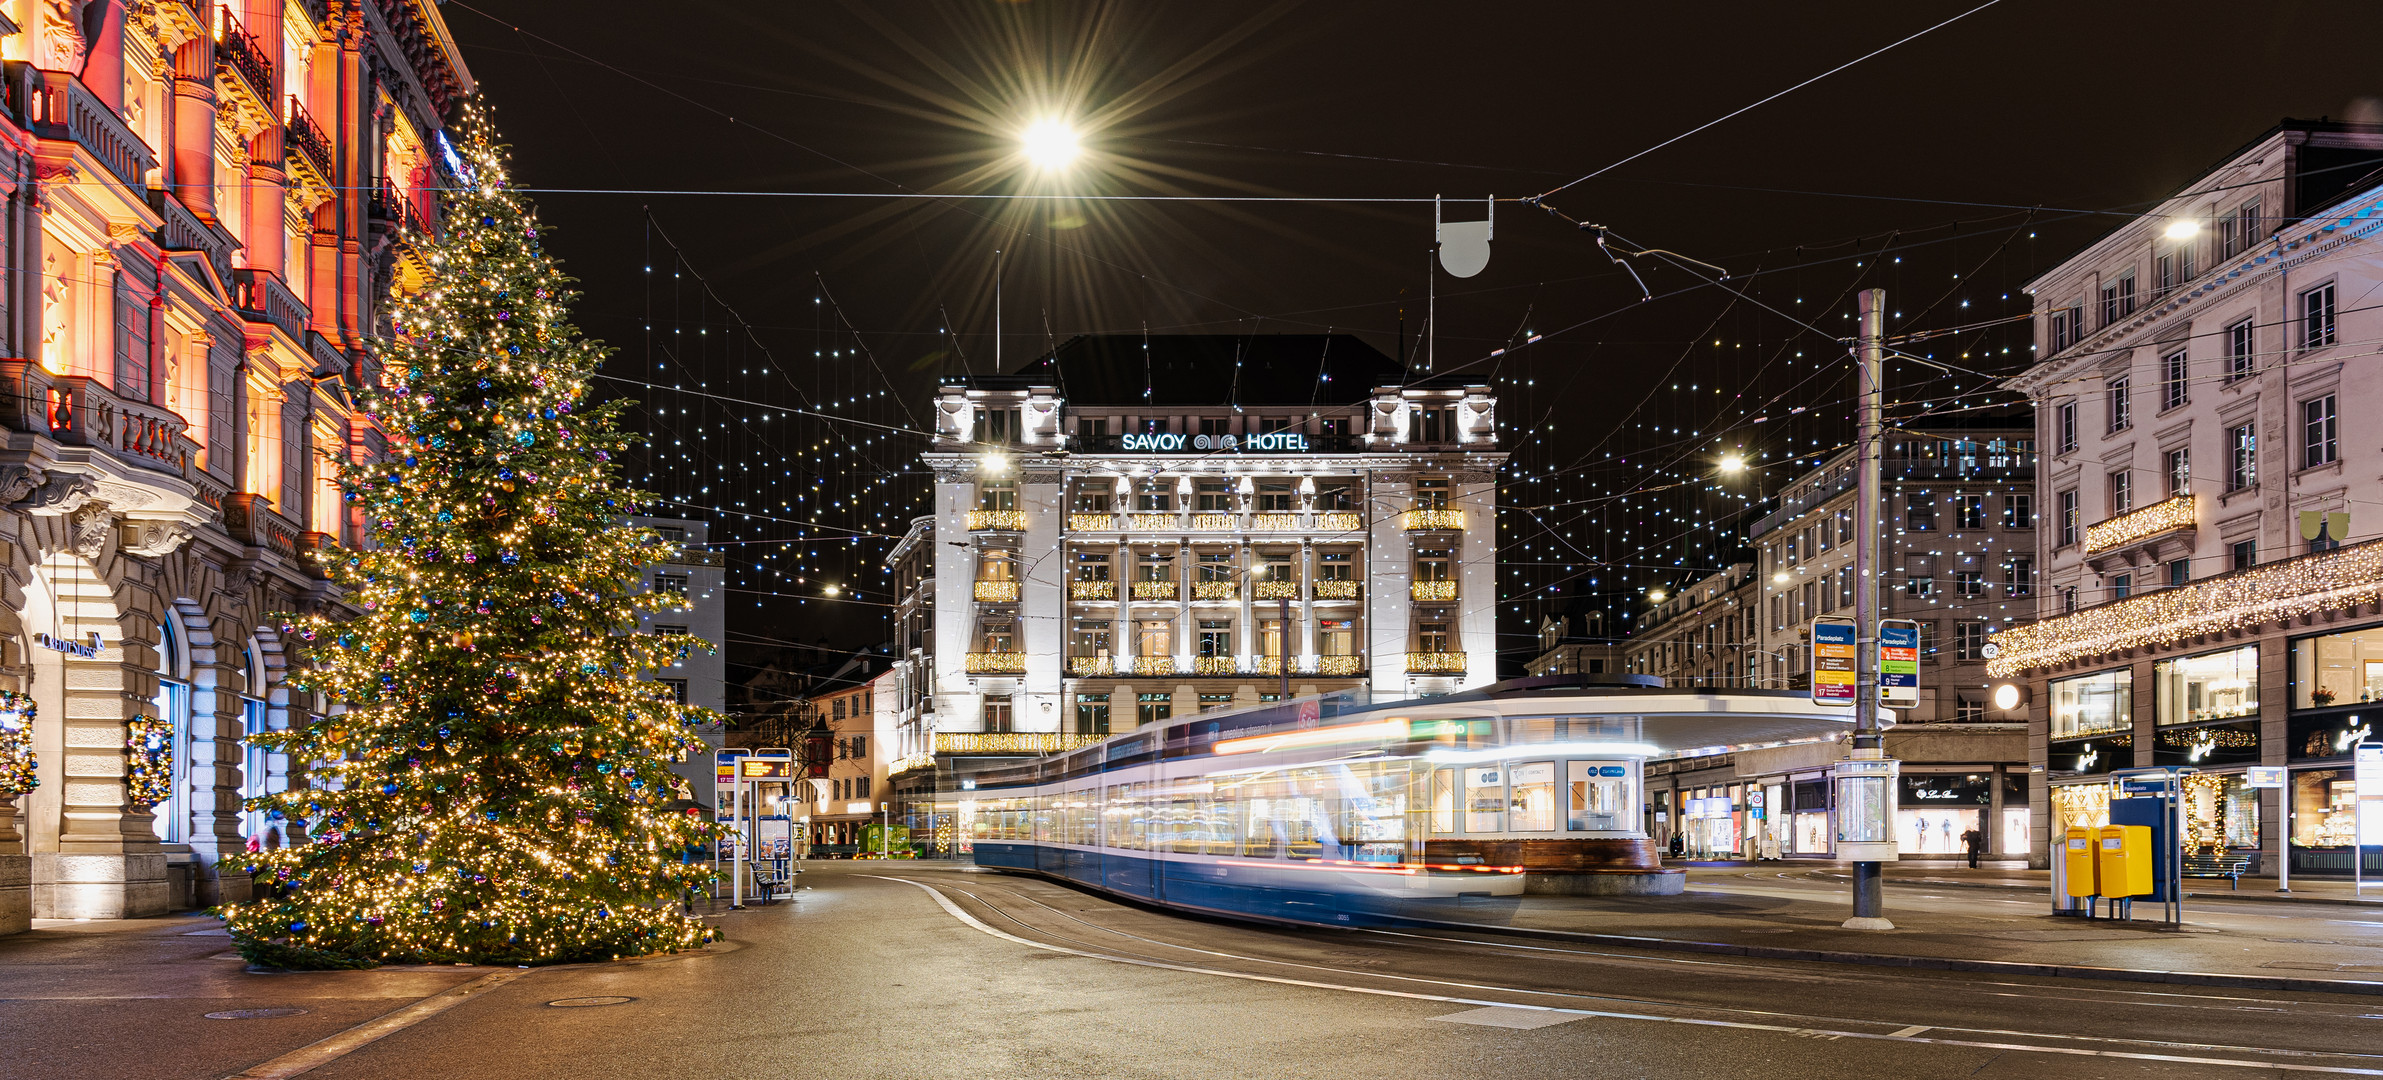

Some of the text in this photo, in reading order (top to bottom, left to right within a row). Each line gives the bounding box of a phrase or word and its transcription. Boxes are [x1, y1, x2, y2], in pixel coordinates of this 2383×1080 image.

[1122, 433, 1309, 449] SAVOY HOTEL
[42, 633, 97, 659] CREDIT SUISSE
[1986, 647, 1995, 655] 12
[1886, 651, 1890, 660] 2
[1818, 688, 1826, 696] 17
[1441, 720, 1465, 734] Zoo
